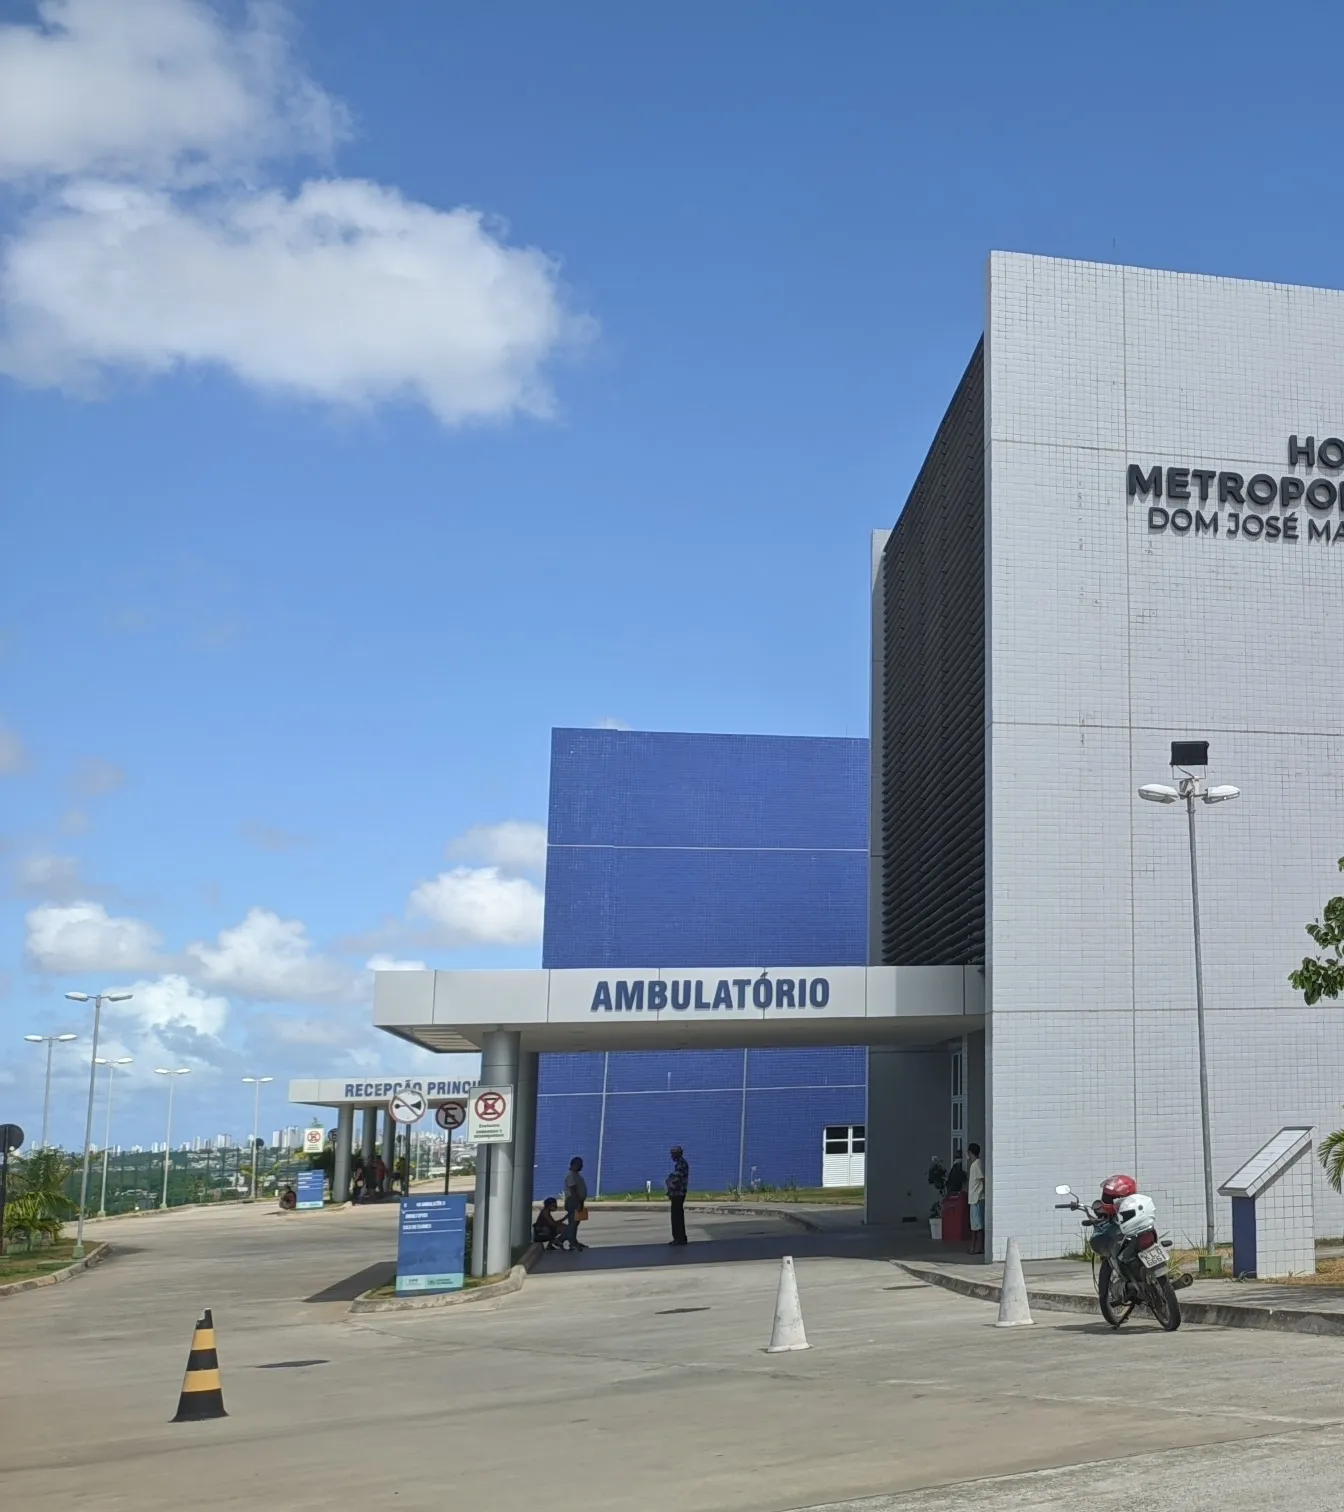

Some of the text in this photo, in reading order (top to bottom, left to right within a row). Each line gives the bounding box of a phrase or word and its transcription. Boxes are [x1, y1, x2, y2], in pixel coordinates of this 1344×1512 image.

[1148, 506, 1219, 532] DOM
[1227, 512, 1299, 540] JOSÉ
[590, 971, 830, 1012] AMBULATÓRIO
